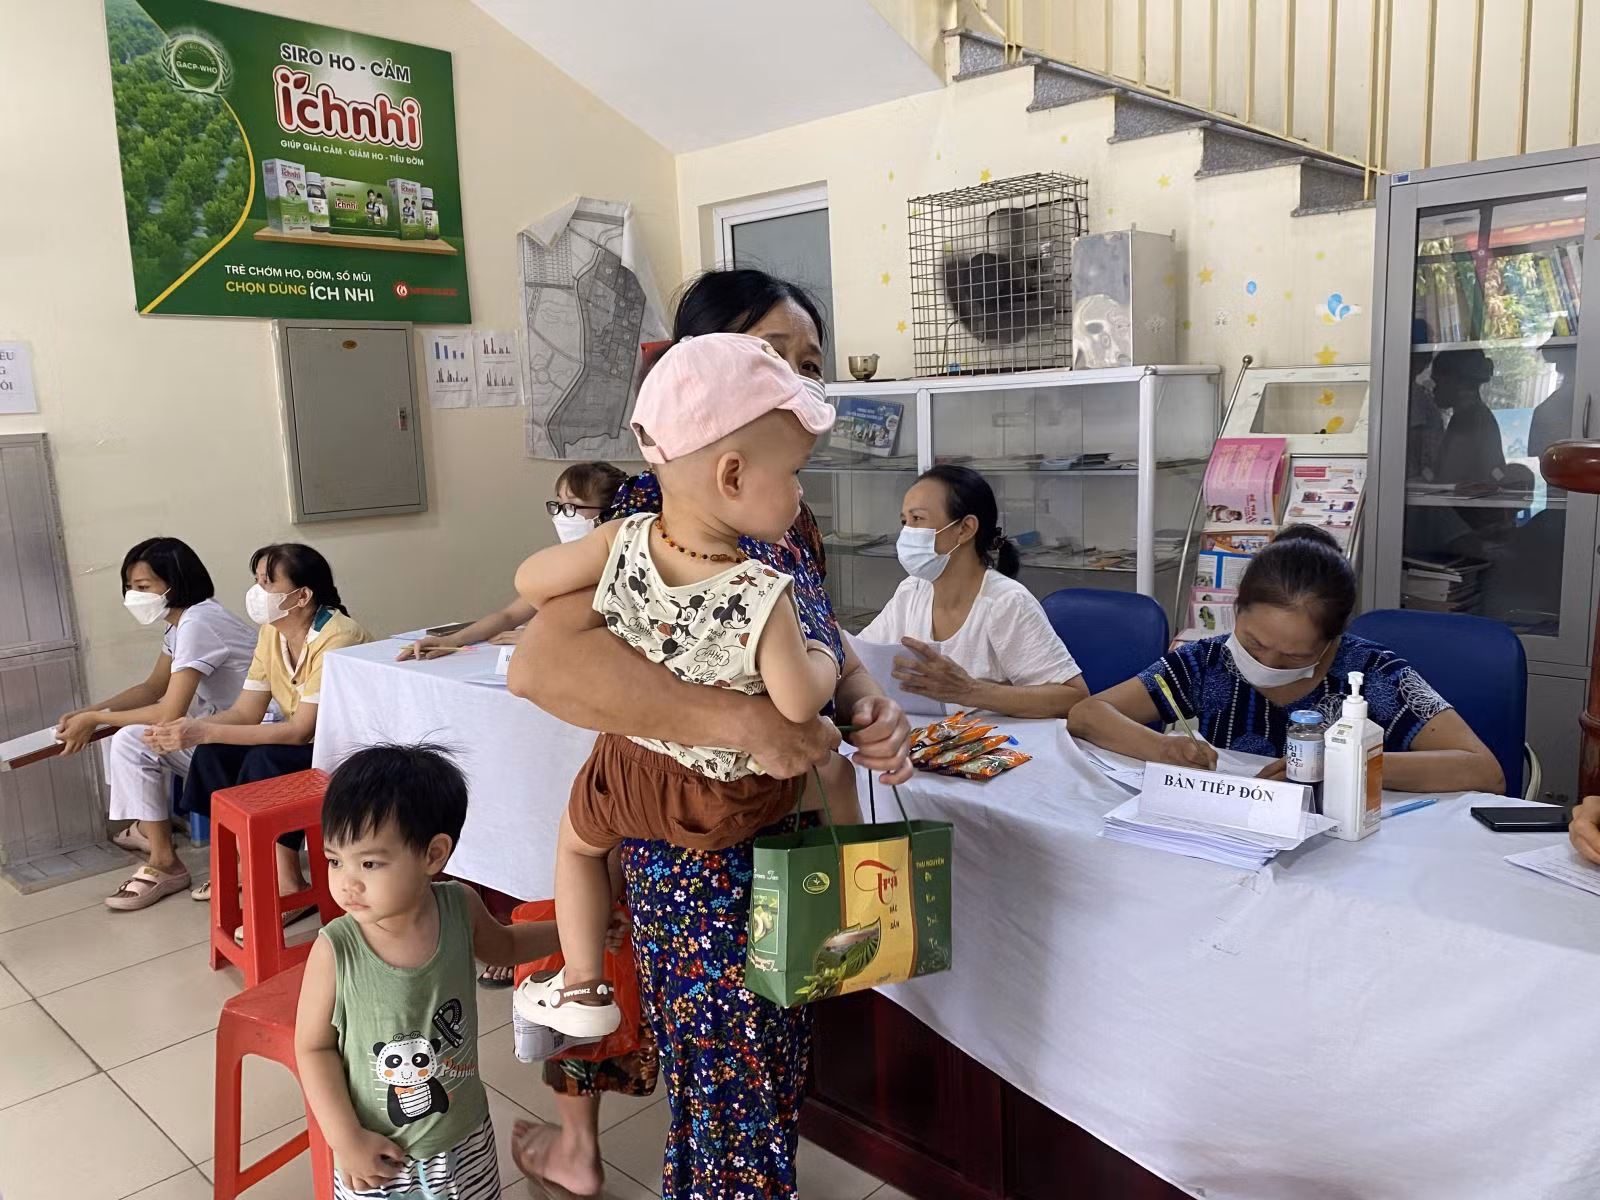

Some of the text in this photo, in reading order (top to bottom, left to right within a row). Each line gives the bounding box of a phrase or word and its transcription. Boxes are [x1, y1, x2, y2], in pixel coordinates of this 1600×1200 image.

[176, 60, 218, 74] GACP-WHO
[281, 44, 324, 66] SIRO
[328, 53, 356, 72] HO
[370, 59, 411, 82] CẢM
[280, 139, 301, 150] GIÚP
[372, 152, 384, 161] HO
[224, 264, 246, 275] TRẺ
[248, 265, 282, 277] CHỚM
[285, 269, 304, 279] HO,
[306, 269, 335, 281] ĐỜM,
[352, 271, 372, 282] MŨI
[225, 281, 374, 302] CHỌN DÙNG ÍCH NHI
[1163, 773, 1275, 803] BÀN TIẾP ĐÓN
